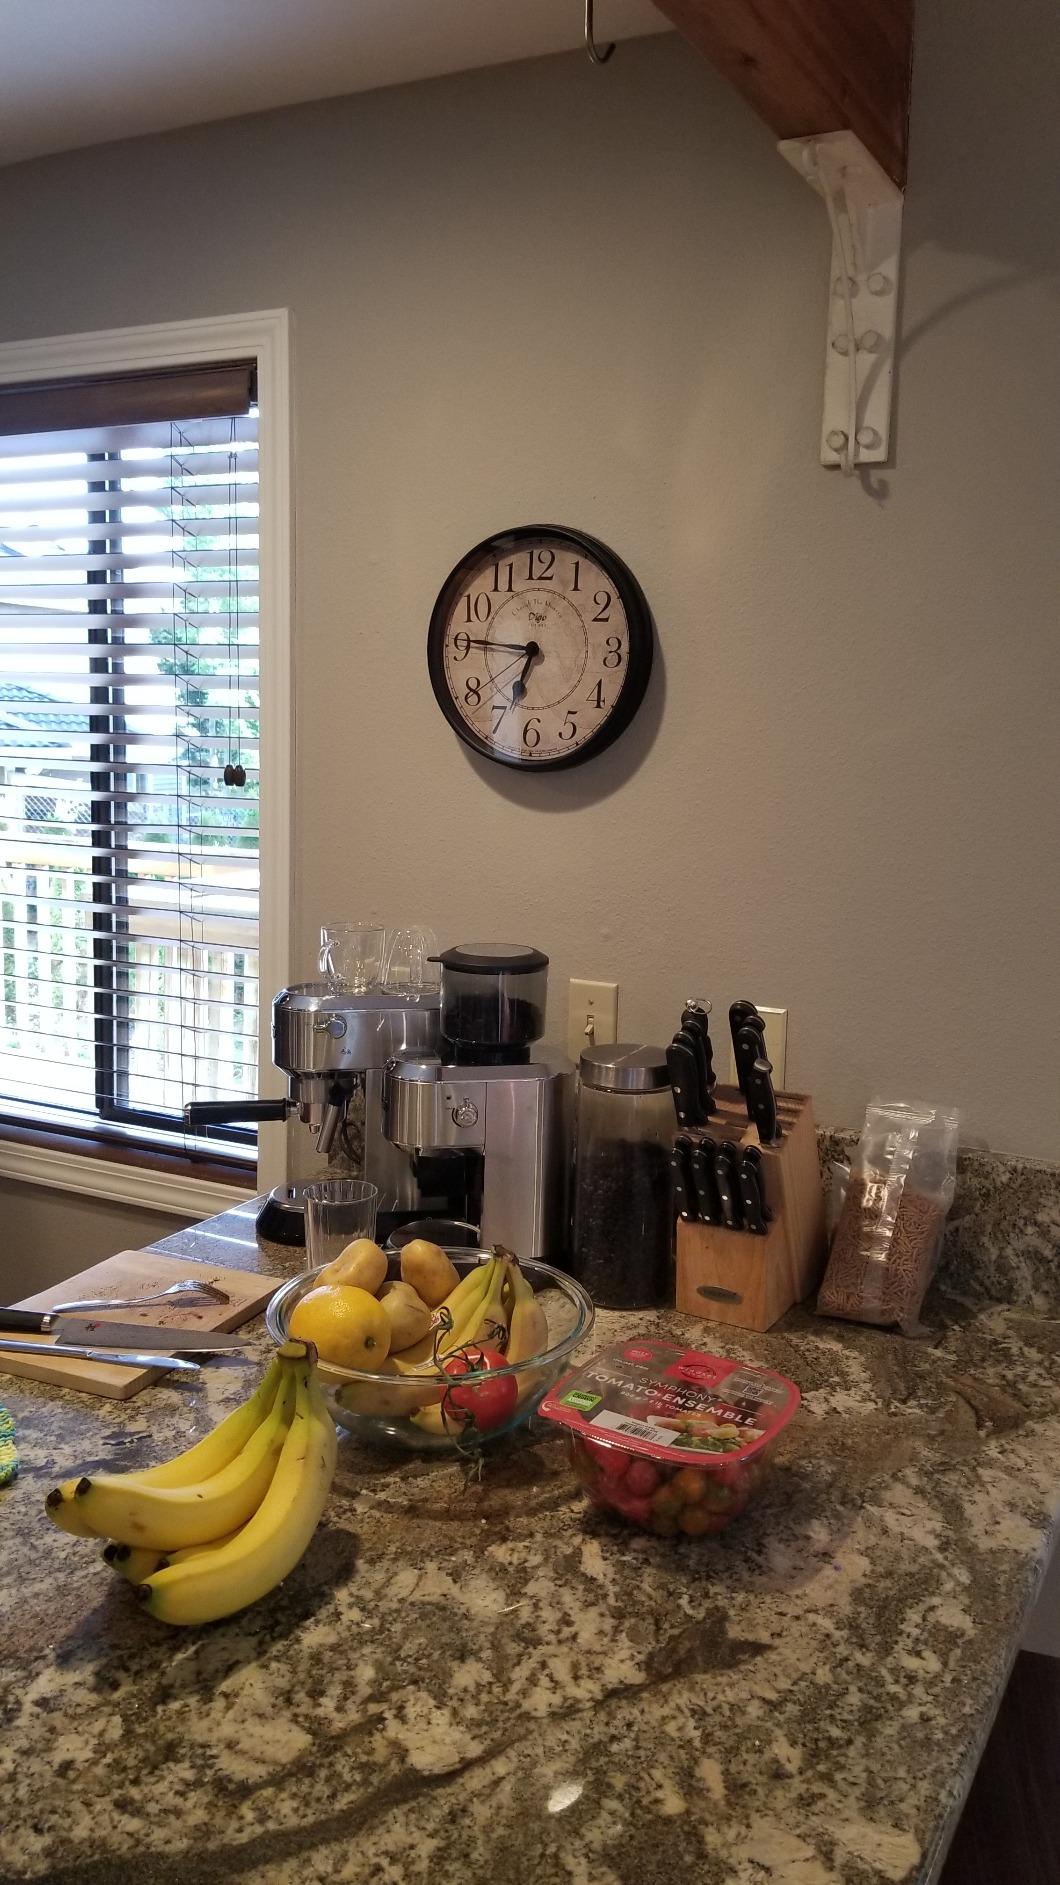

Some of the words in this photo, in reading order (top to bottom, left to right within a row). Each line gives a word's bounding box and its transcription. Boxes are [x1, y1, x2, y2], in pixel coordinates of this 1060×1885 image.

[490, 562, 516, 592] 11
[525, 550, 555, 580] 12
[570, 561, 582, 592] 1
[463, 592, 492, 623] 10
[592, 590, 611, 623] 2
[453, 632, 471, 661] 9
[603, 637, 622, 668] 3
[464, 677, 482, 706] 8
[586, 679, 605, 709] 4
[491, 705, 507, 734] 7
[522, 717, 541, 748] 6
[558, 711, 578, 740] 5
[585, 1372, 657, 1397] TOMATO
[662, 1393, 758, 1426] ENSEMBLE
[639, 1377, 717, 1404] SYMPHONY
